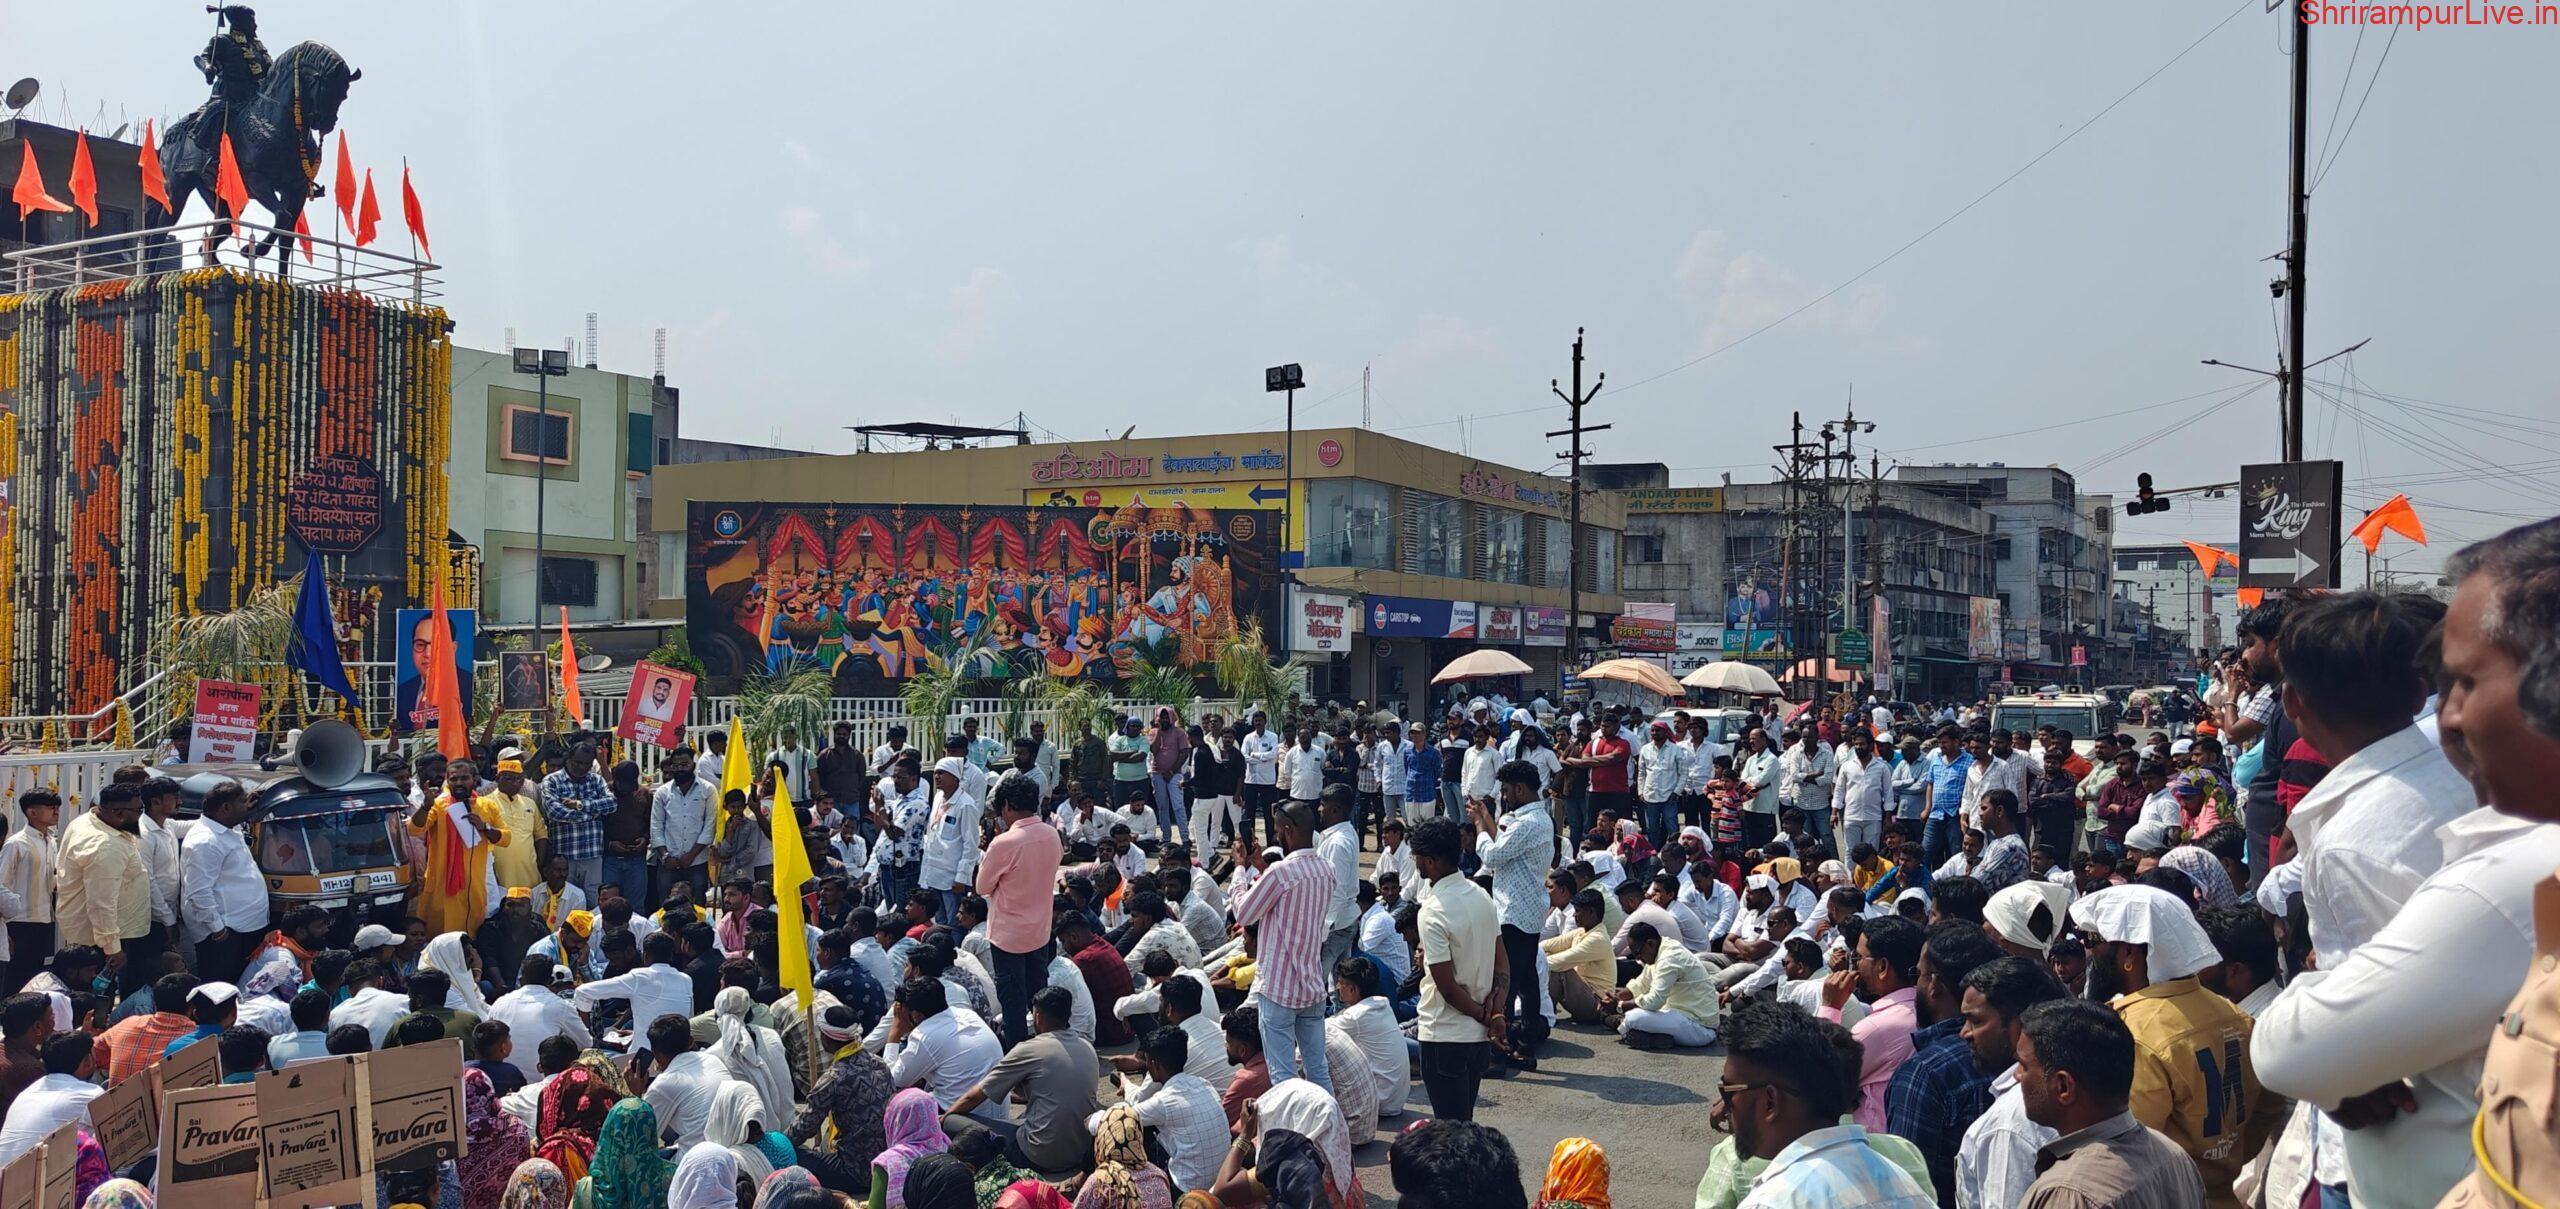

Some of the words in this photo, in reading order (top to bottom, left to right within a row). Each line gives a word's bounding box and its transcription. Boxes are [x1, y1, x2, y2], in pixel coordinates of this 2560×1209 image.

[1031, 445, 1153, 482] हरिओम
[2252, 492, 2313, 540] King
[1695, 637, 1719, 646] JOCKEY
[1727, 633, 1758, 643] Bislri
[189, 1118, 202, 1126] Sai
[280, 1136, 327, 1157] Pravara
